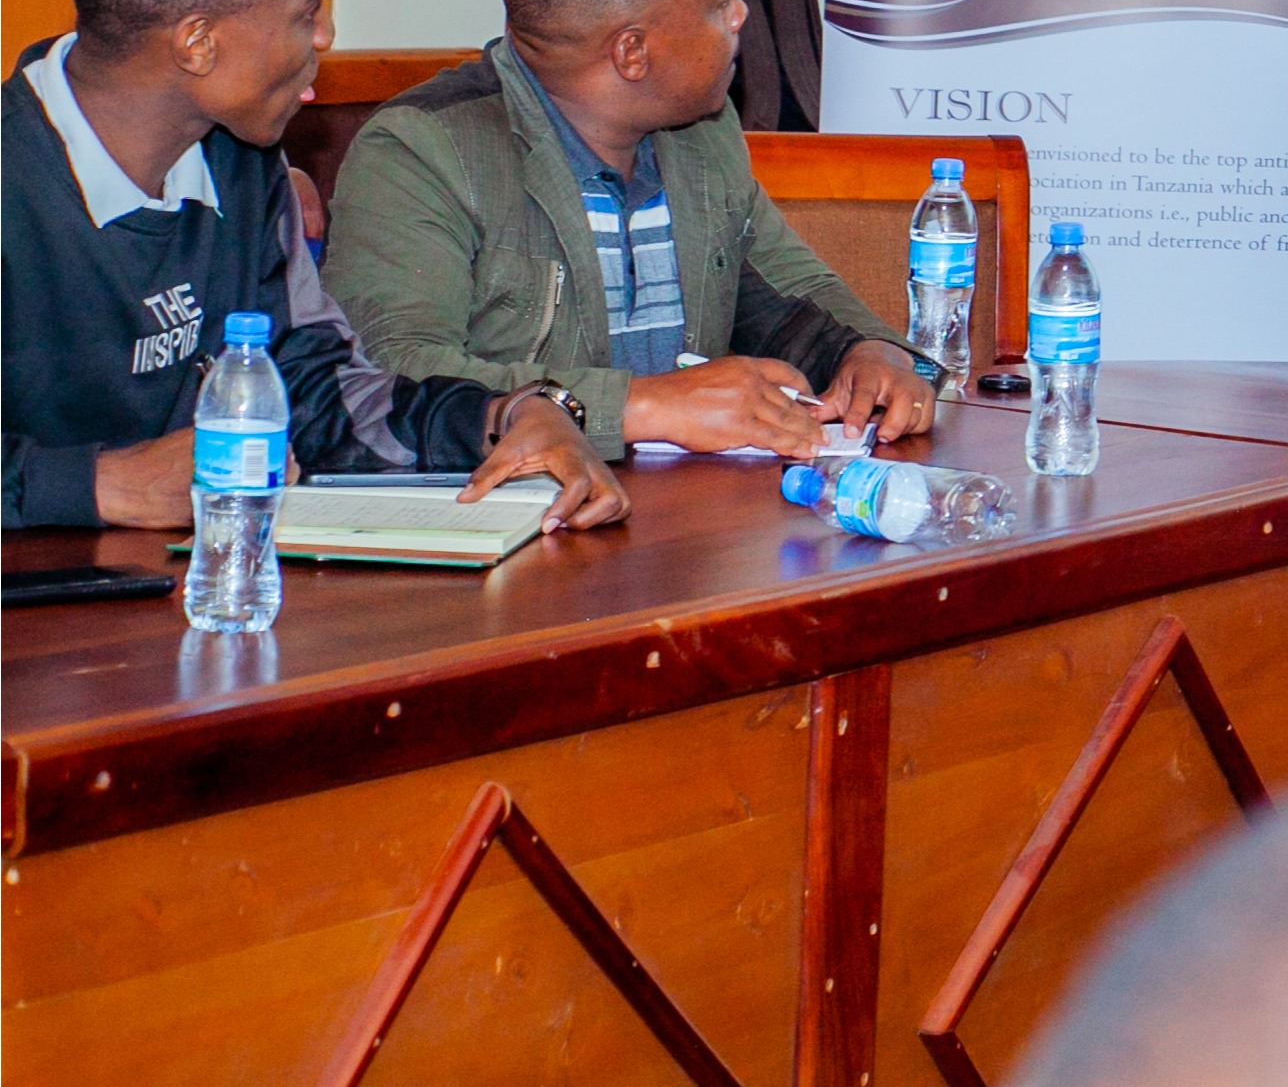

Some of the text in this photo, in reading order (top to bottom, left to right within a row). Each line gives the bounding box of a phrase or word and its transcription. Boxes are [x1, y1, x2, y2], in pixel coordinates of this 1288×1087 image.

[889, 87, 1073, 125] VISION
[1027, 145, 1122, 163] envisioned
[1129, 151, 1148, 164] to
[1155, 148, 1175, 165] be
[1182, 149, 1210, 166] the
[1217, 154, 1248, 172] top
[1110, 175, 1274, 196] in Tanzania which
[1030, 201, 1153, 223] organizations
[1160, 204, 1189, 222] i.e.,
[1197, 205, 1253, 227] public
[1108, 230, 1140, 247] and
[1148, 231, 1242, 251] deterrence
[1248, 234, 1271, 251] of
[143, 283, 203, 329] THE
